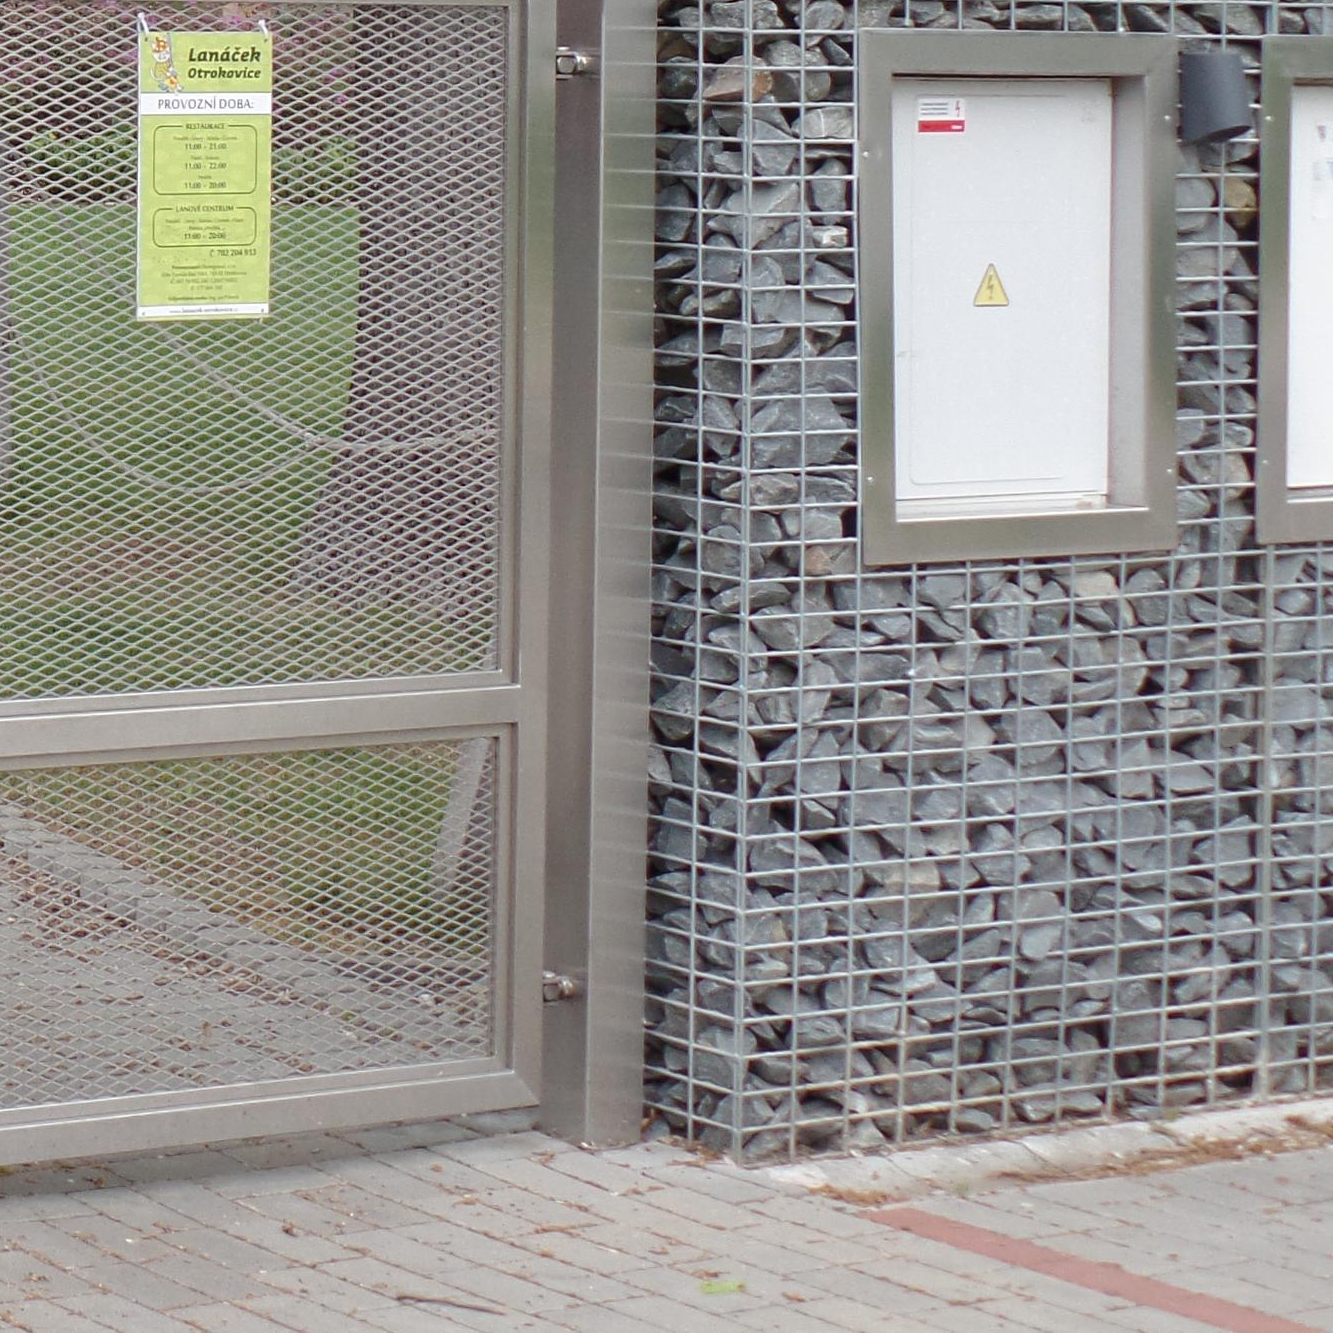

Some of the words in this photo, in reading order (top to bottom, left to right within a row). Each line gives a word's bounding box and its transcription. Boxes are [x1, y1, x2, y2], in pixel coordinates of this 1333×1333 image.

[188, 46, 262, 63] Lanáček
[187, 66, 262, 79] Otrokovice
[157, 95, 217, 110] PROVOZNÍ
[219, 98, 254, 109] DOBA:
